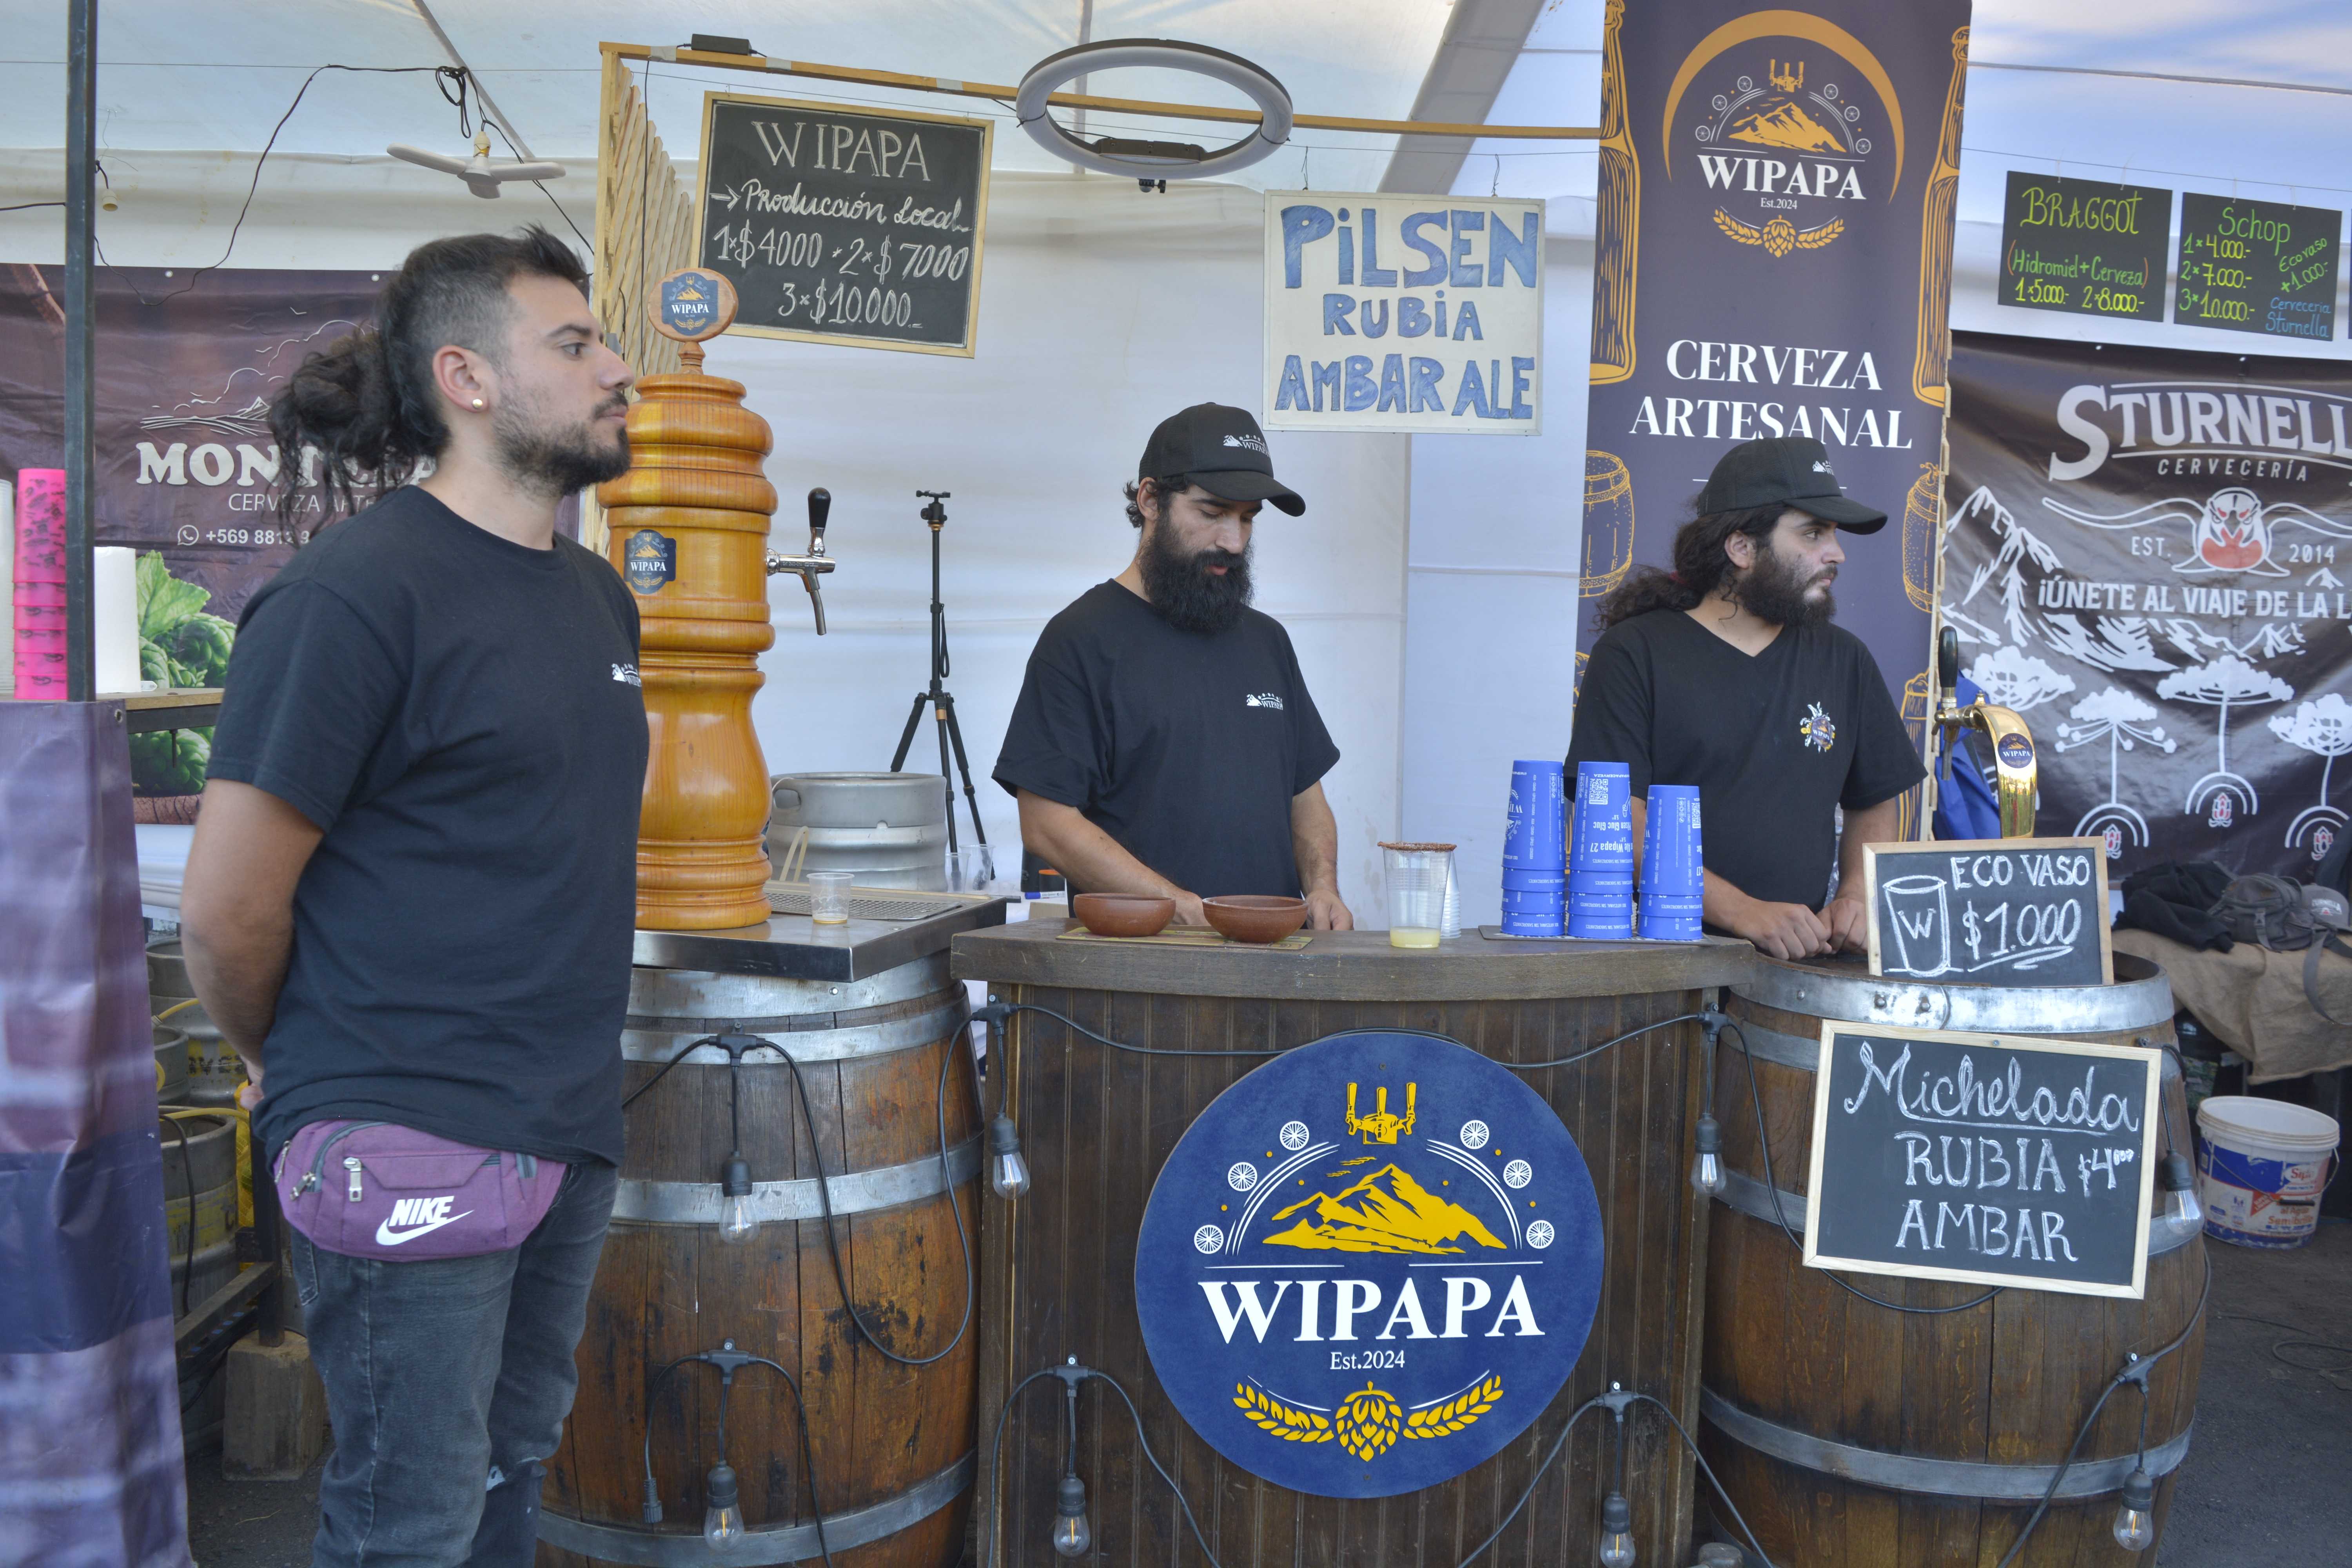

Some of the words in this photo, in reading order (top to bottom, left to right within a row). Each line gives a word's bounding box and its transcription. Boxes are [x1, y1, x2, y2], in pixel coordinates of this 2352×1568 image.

[751, 121, 931, 181] WIPAPA
[1697, 154, 1866, 200] WIPAPA
[894, 196, 972, 233] Local
[1760, 197, 1798, 210] Est.2024
[2218, 207, 2290, 256] Schop
[671, 303, 710, 314] WIPAPA
[2265, 312, 2330, 338] Sturnella
[1666, 339, 1882, 391] CERVEZA
[1274, 353, 1445, 413] AMBAR
[1451, 356, 1535, 419] ALE
[1628, 396, 1913, 450] ARTESANAL
[2158, 457, 2307, 481] CERVECERÍA
[229, 493, 320, 513] CERVZA
[206, 529, 249, 544] +569
[2131, 535, 2172, 557] EST.
[2289, 543, 2335, 564] 2014
[630, 561, 667, 571] WIPAPA
[2142, 585, 2177, 612] AL
[2181, 586, 2248, 619] VIAJE
[2254, 590, 2289, 617] DE
[2296, 592, 2329, 619] LA
[1590, 842, 1599, 853] 27
[1600, 841, 1624, 853] Wipapa
[1950, 855, 2014, 890] ECO
[2020, 854, 2091, 887] VASO
[1896, 908, 1937, 940] W
[1962, 898, 2082, 961] $1.000
[1843, 1040, 2140, 1135] Michelada
[1894, 1130, 2067, 1194] RUBIA
[388, 1195, 454, 1227] NIKE
[1895, 1199, 2079, 1263] AMBAR
[1198, 1275, 1546, 1344] WIPAPA
[1329, 1350, 1405, 1370] Est.2024
